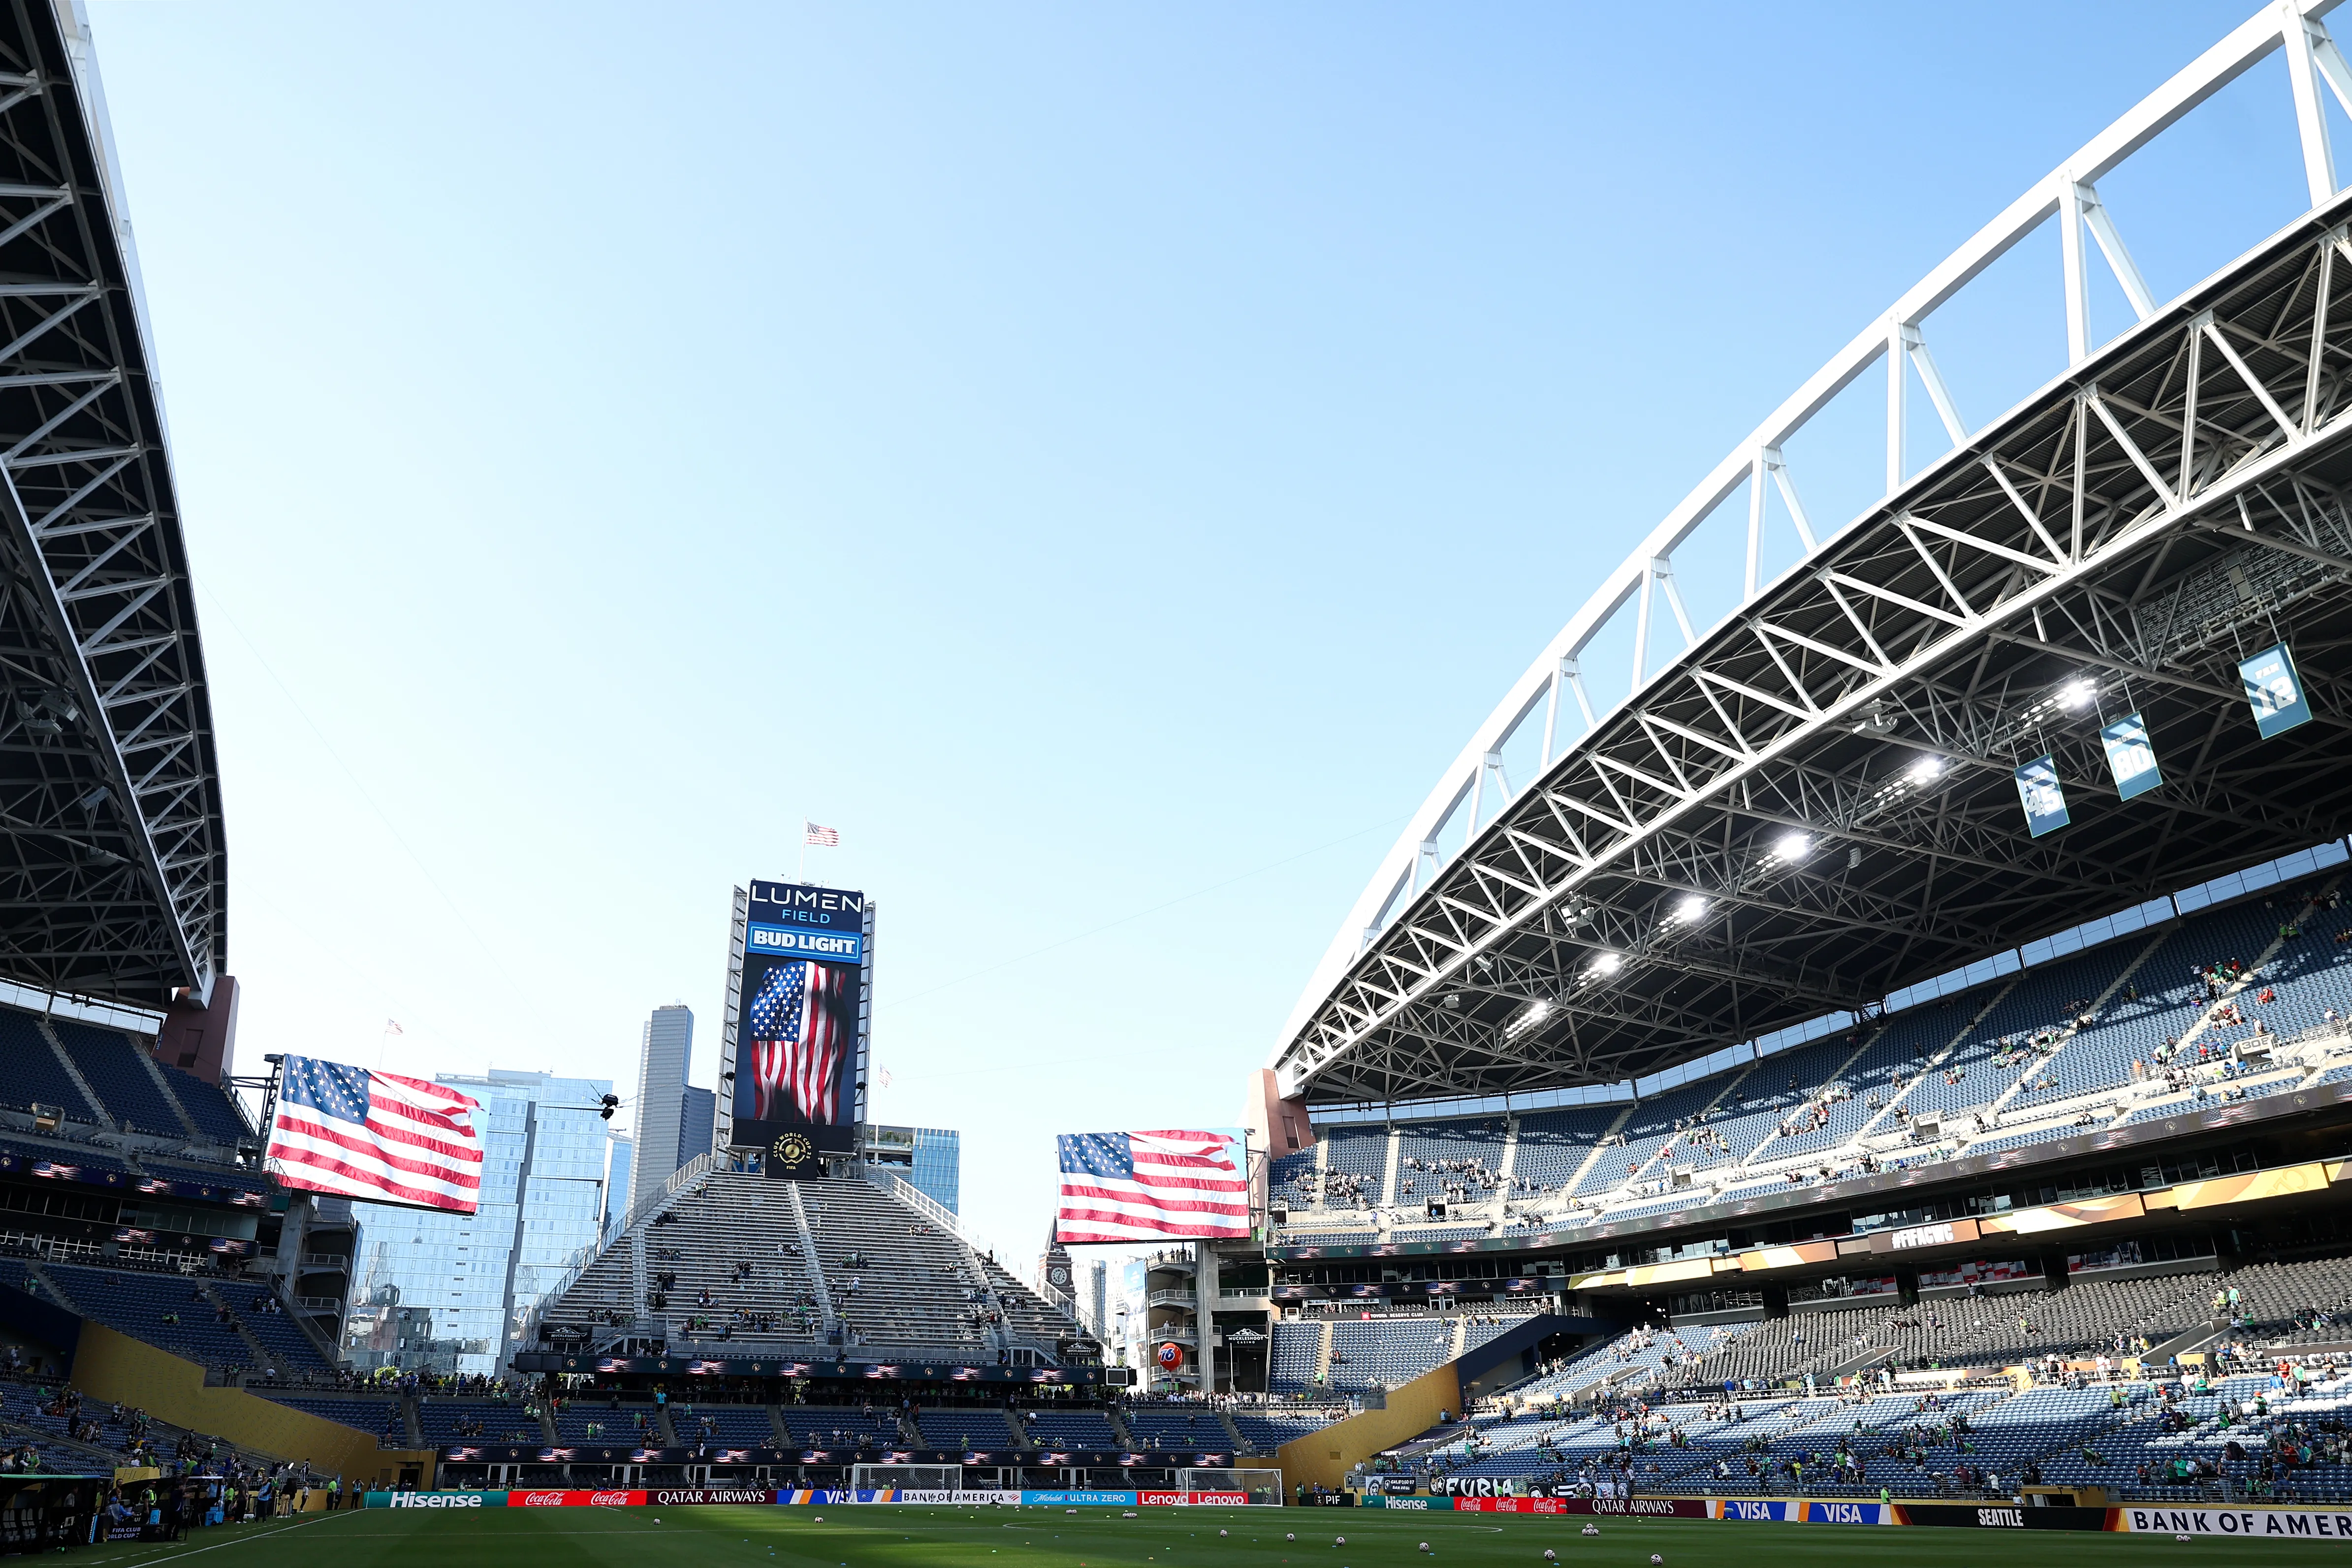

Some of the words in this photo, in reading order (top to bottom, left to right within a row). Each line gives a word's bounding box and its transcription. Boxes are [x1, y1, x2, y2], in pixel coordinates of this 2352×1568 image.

[2256, 676, 2297, 716] 12
[2113, 742, 2152, 780] 80
[2027, 783, 2061, 817] 45
[751, 885, 862, 913] LUMEN
[782, 909, 830, 924] FIELD
[754, 930, 796, 948] BUD
[798, 935, 856, 954] LIGHT
[240, 1138, 261, 1147] 344
[803, 1138, 812, 1150] CUP
[1891, 1223, 1954, 1249] #FIFACWC
[1160, 1347, 1175, 1362] 76
[390, 1492, 482, 1507] Hisense
[525, 1492, 566, 1505] Coca-Cola
[591, 1492, 630, 1505] Coca-Cola
[658, 1491, 703, 1505] QATAR
[708, 1491, 765, 1502] AIRWAYS
[823, 1490, 858, 1504] VISA
[954, 1493, 1004, 1502] AMERICA
[1033, 1494, 1064, 1502] Michelob
[1141, 1493, 1188, 1504] Lenovo
[1198, 1494, 1244, 1505] Lenovo
[1325, 1495, 1340, 1504] PIF
[1385, 1496, 1427, 1510] Hisense
[1461, 1498, 1481, 1511] Coca-Cola
[1496, 1498, 1517, 1512] Coca-Cola
[1533, 1499, 1557, 1512] Coca-Cola
[1592, 1500, 1625, 1515] QATAR
[1630, 1501, 1674, 1514] AIRWAYS
[1734, 1502, 1771, 1520] VISA
[1820, 1504, 1863, 1523] VISA
[1978, 1509, 2024, 1527] SEATTLE
[2133, 1511, 2211, 1532] BANK
[2218, 1513, 2254, 1533] OF
[2266, 1514, 2352, 1536] AMER
